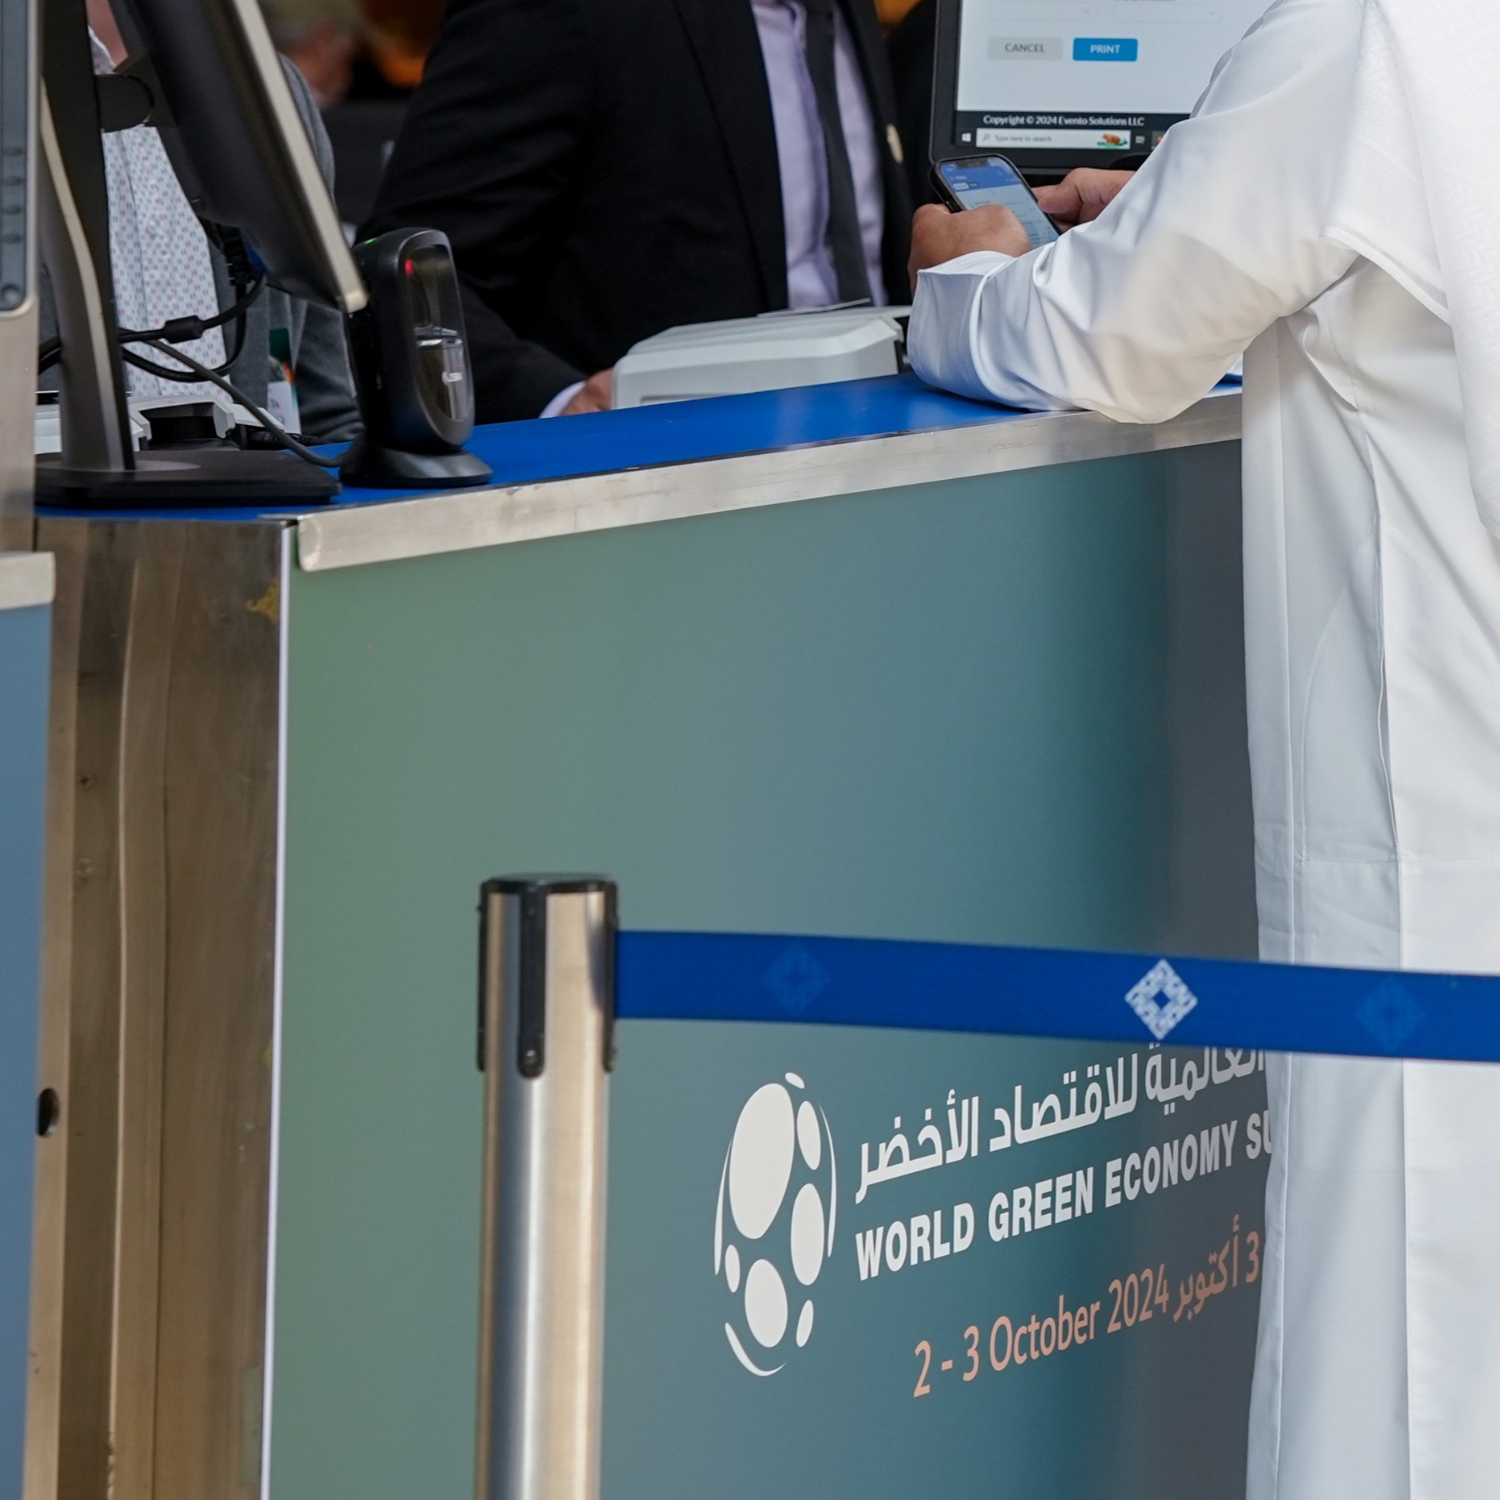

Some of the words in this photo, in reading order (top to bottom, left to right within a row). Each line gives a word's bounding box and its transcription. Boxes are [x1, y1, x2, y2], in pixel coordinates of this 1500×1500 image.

[1004, 43, 1045, 53] CANCEL
[1090, 44, 1121, 54] PRINT
[982, 114, 1025, 126] Copyright
[1035, 115, 1058, 125] 2024
[1058, 115, 1088, 125] Evento
[1088, 115, 1127, 126] Solutions
[1127, 116, 1145, 126] LLC
[855, 1089, 979, 1204] الأخضر
[989, 1052, 1138, 1152] للاقتصاد
[855, 1202, 975, 1281] WORLD
[988, 1166, 1094, 1242] GREEN
[1105, 1120, 1238, 1208] ECONOMY
[1173, 1214, 1240, 1323] أكتوبر
[913, 1340, 932, 1398] 2
[962, 1326, 980, 1382] 3
[989, 1295, 1100, 1371] October
[1107, 1263, 1169, 1333] 2024
